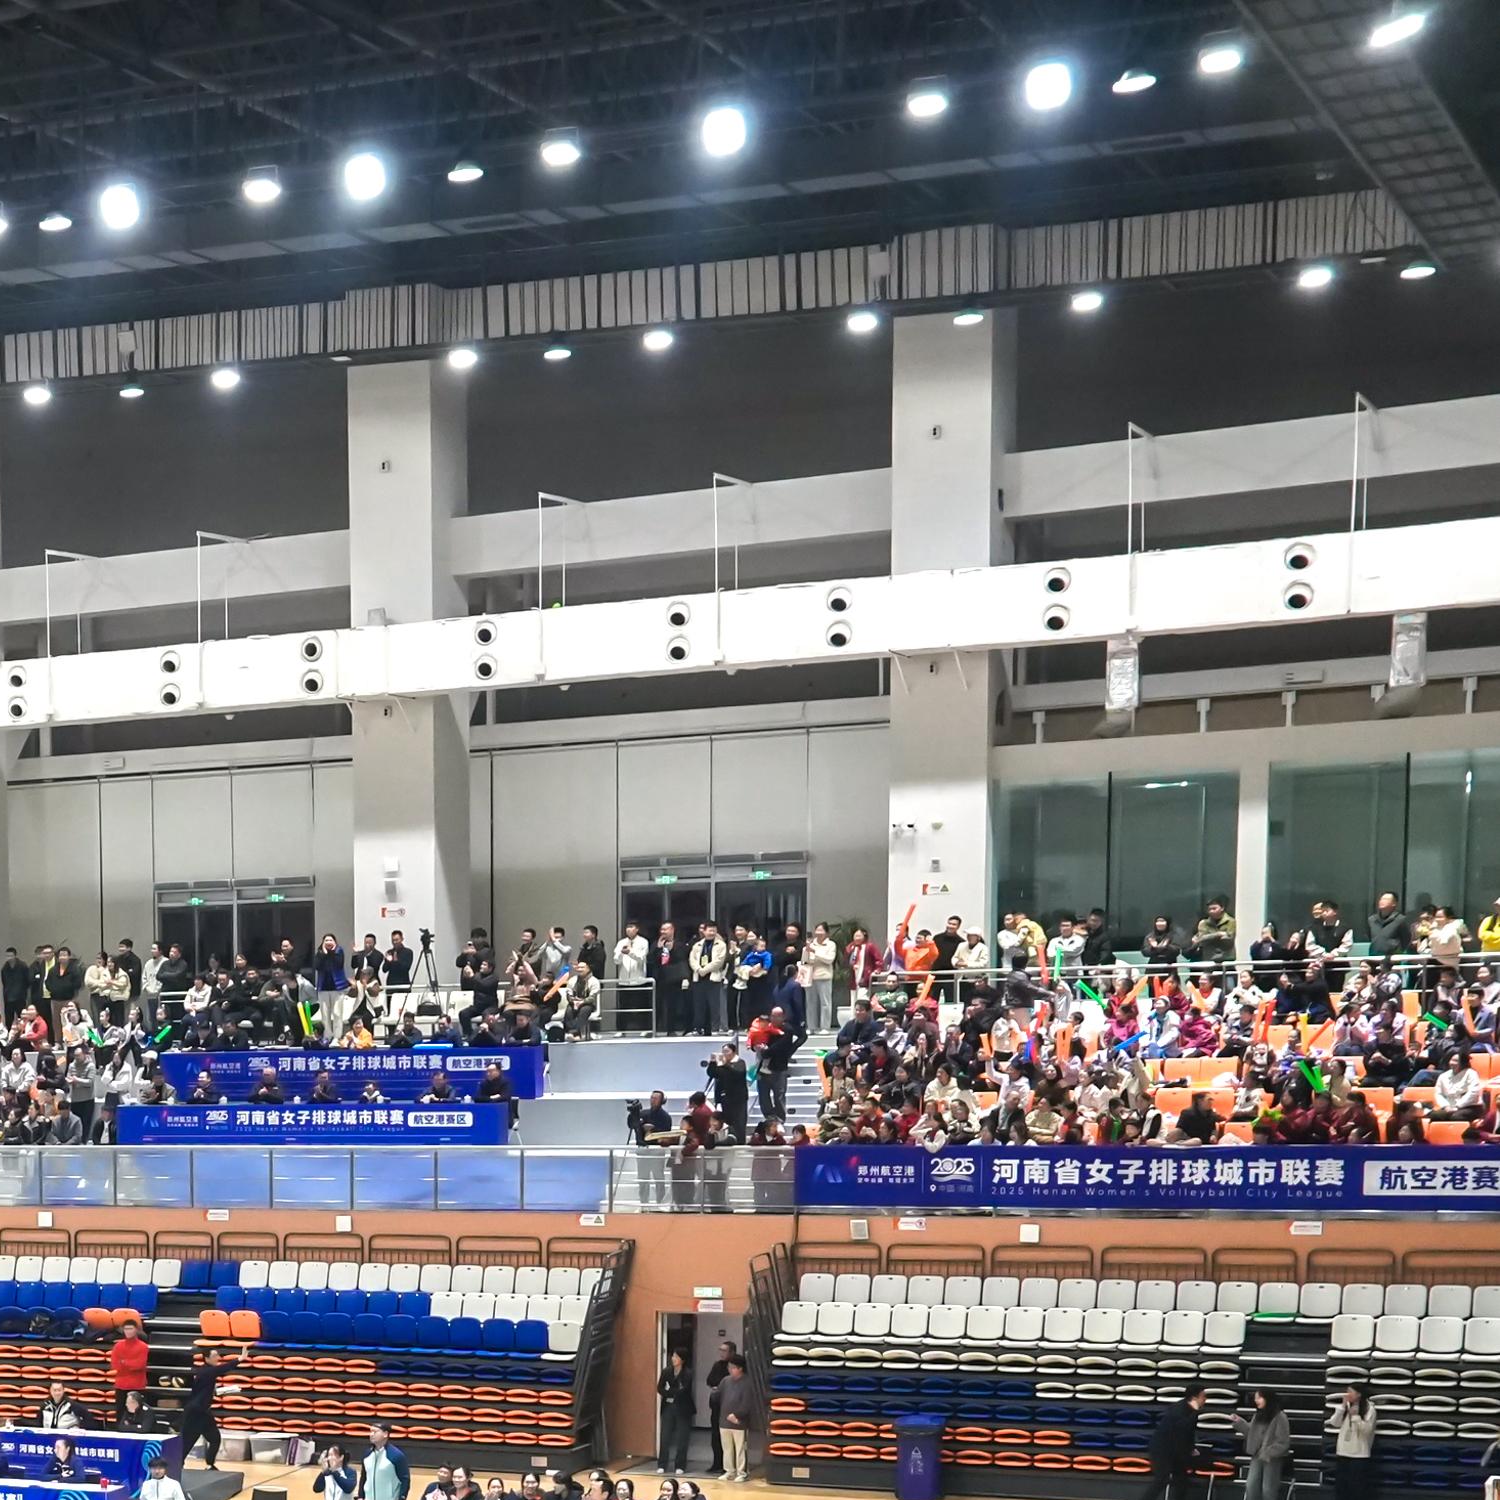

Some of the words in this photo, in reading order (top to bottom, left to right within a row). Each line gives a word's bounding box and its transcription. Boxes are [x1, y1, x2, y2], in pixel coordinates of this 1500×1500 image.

[278, 1055, 443, 1071] 河南省女子排球城市联赛
[236, 1110, 405, 1125] 河南省女子排球城市联赛
[413, 1114, 468, 1125] 航空港赛区
[857, 1165, 915, 1176] 郑州航空港
[930, 1157, 975, 1175] 2025
[991, 1159, 1344, 1186] 河南省女子排球城市联赛
[1379, 1166, 1499, 1190] 航空港赛
[991, 1187, 1024, 1195] 2025
[1032, 1187, 1077, 1195] Henan
[1158, 1187, 1238, 1198] Volleyball
[1246, 1187, 1278, 1198] City
[1286, 1187, 1343, 1198] League
